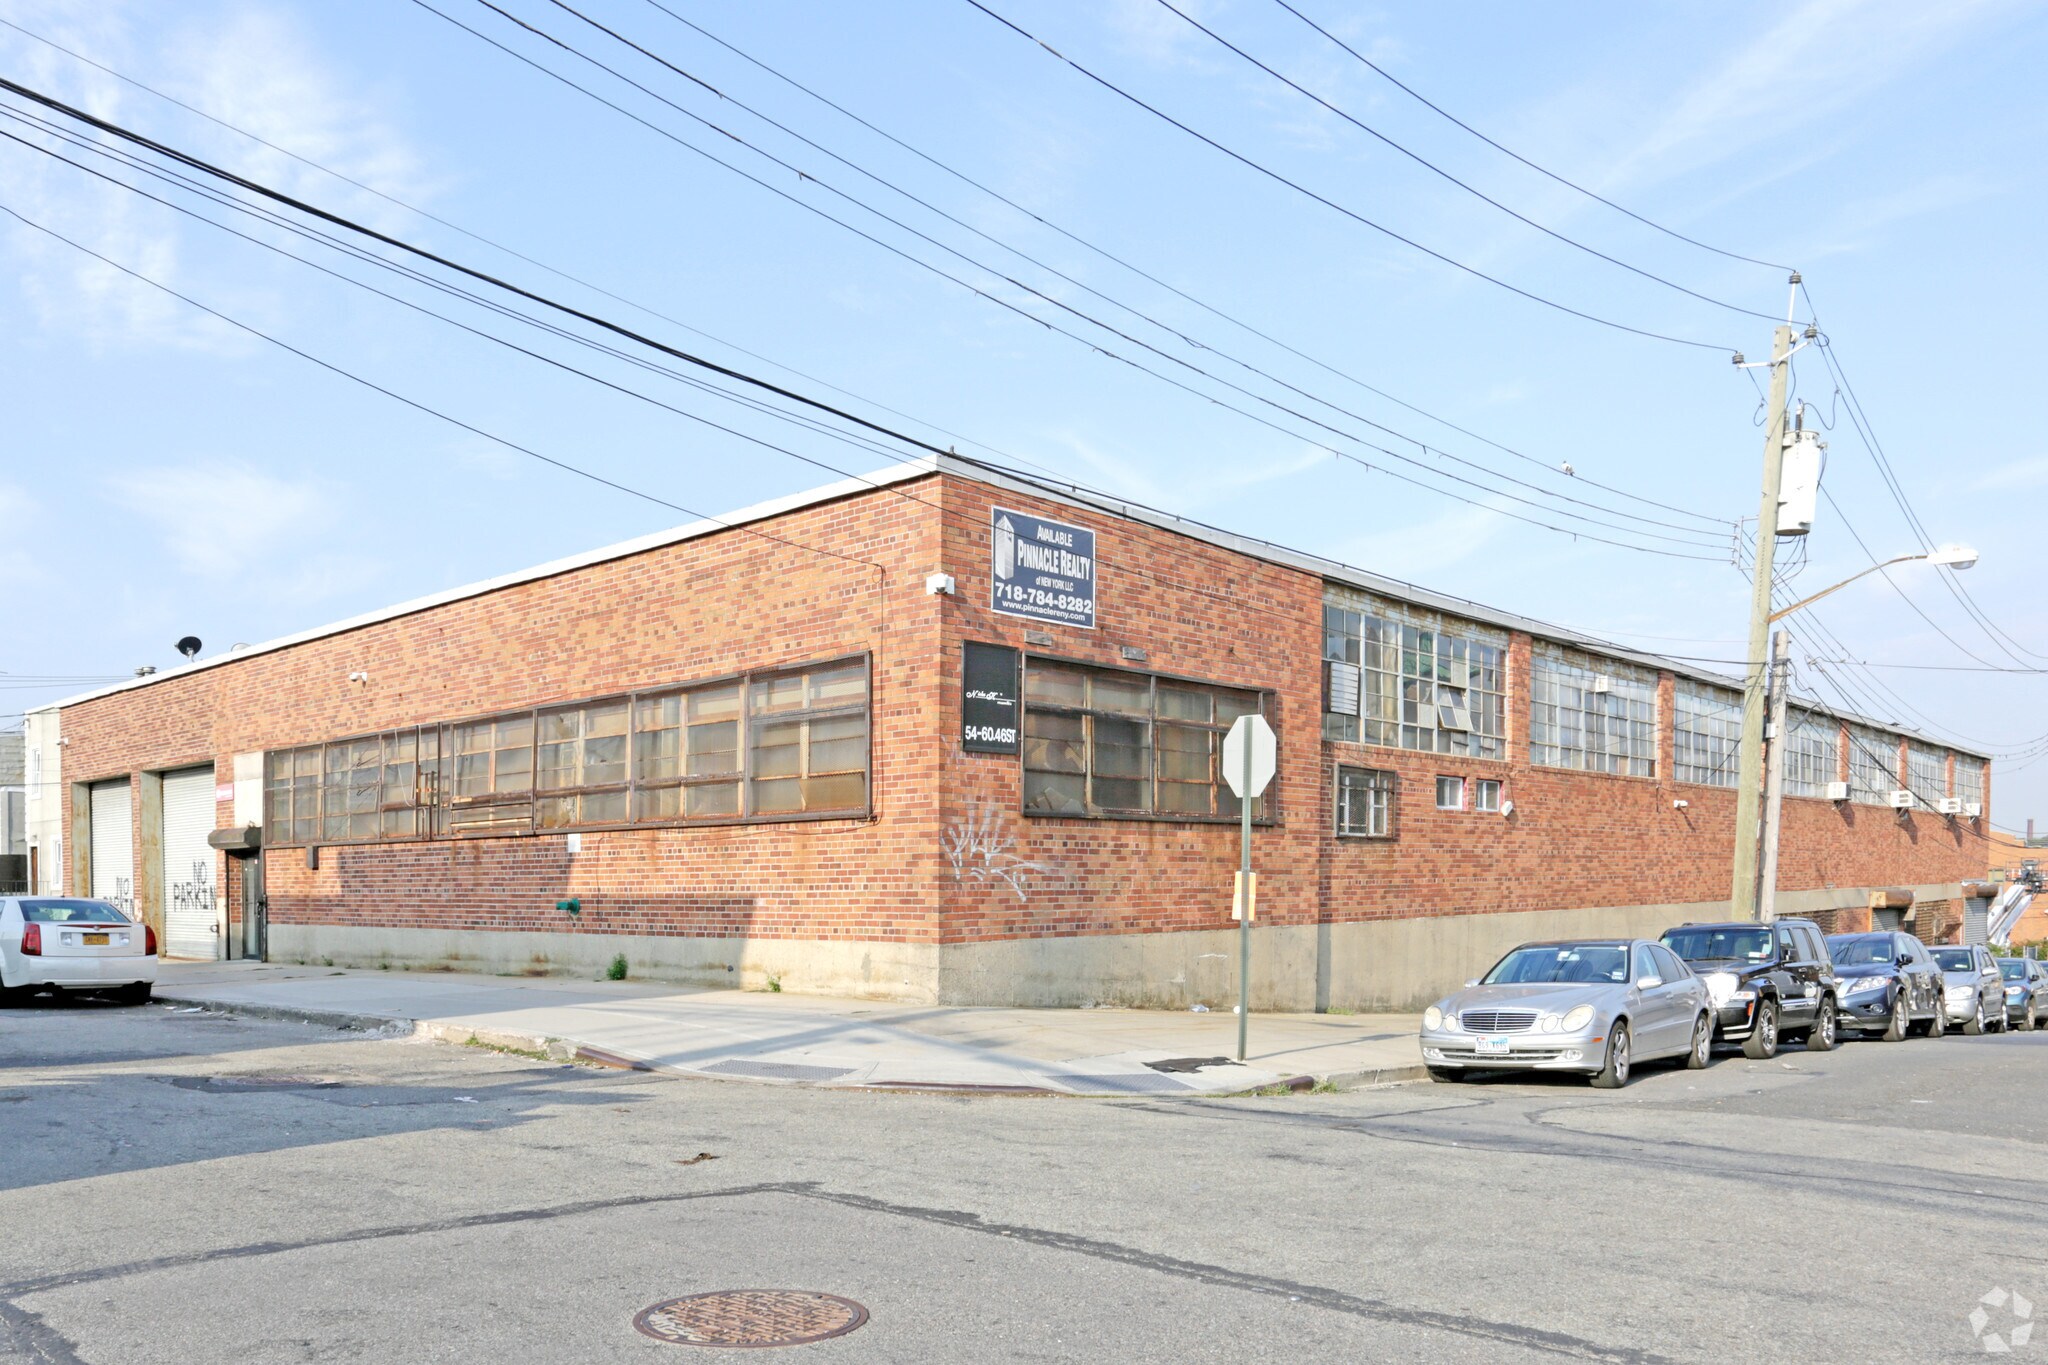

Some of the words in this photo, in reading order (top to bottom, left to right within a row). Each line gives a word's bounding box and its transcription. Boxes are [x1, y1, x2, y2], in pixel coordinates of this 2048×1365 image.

[1036, 524, 1073, 547] AVAILABLE
[1017, 539, 1059, 575] PINNACLE
[1060, 549, 1091, 580] REALTY
[1041, 576, 1052, 588] NEW
[1051, 578, 1065, 591] YORK
[1064, 581, 1074, 592] LLC
[995, 581, 1092, 614] 718-784-8282
[1002, 600, 1086, 621] www.pinnaclereny.com
[193, 860, 208, 885] NO
[116, 876, 130, 896] NO
